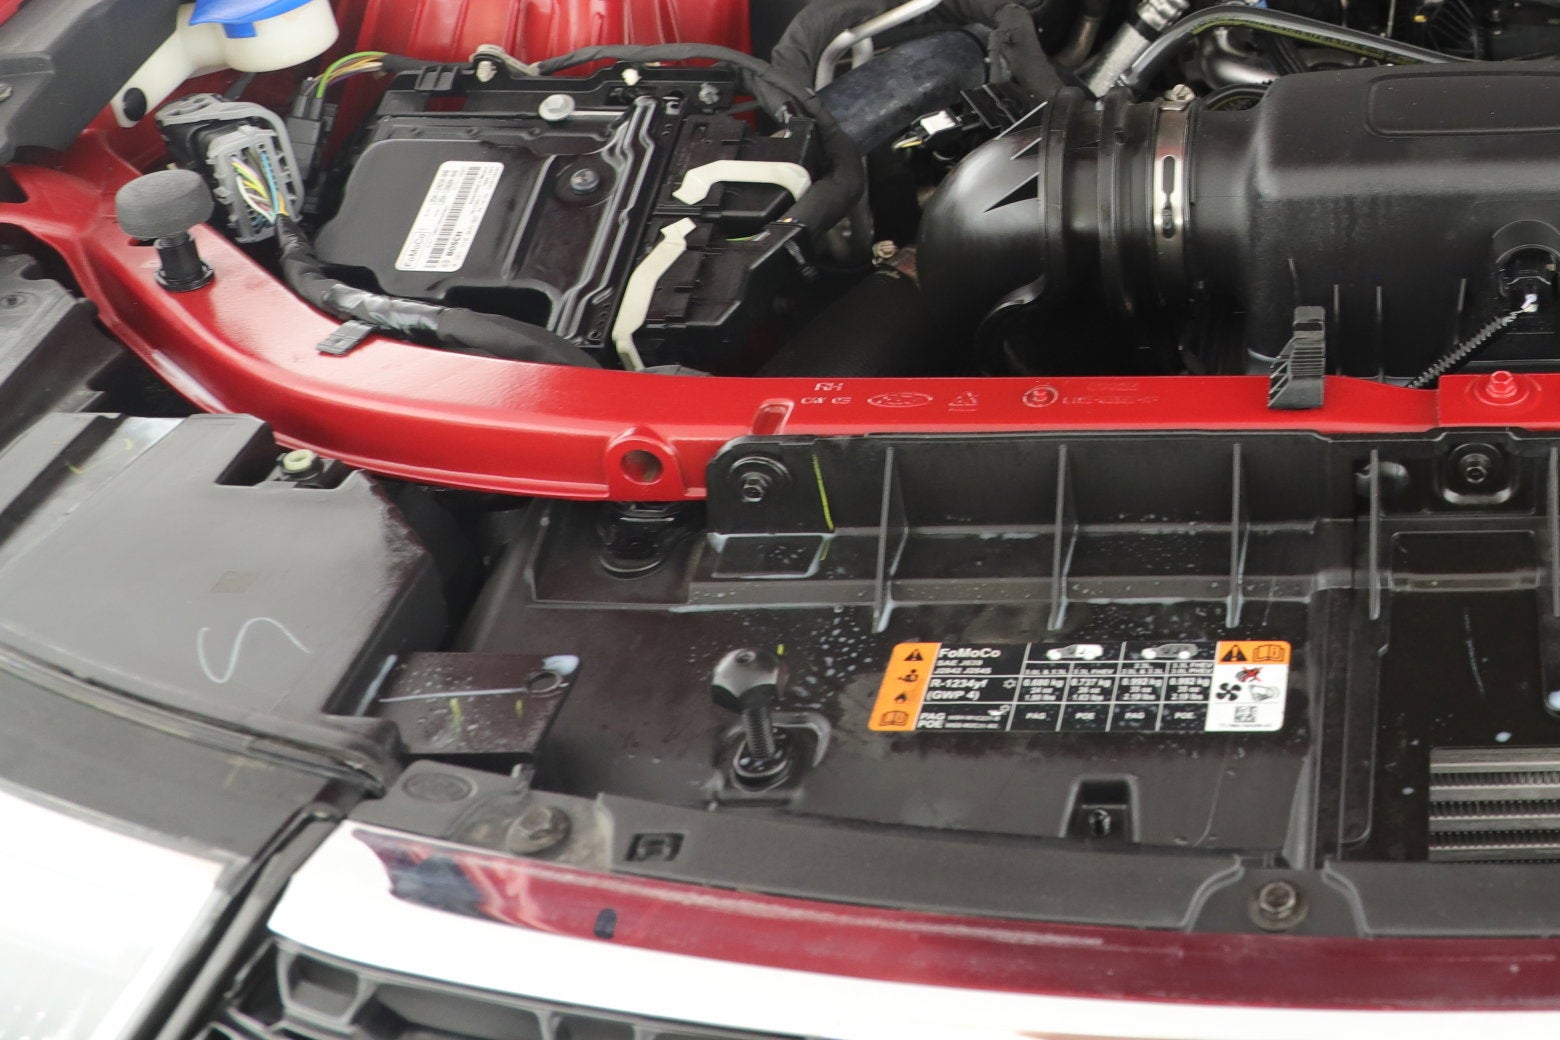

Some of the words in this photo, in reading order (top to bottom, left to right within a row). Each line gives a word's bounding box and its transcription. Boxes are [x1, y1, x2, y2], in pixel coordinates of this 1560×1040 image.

[446, 231, 463, 257] BOSCH
[938, 647, 1002, 658] FoMoCo
[929, 678, 989, 689] R-1234yf
[1050, 678, 1065, 688] kg
[1097, 678, 1112, 688] kg
[1149, 677, 1163, 687] kg
[1197, 677, 1210, 687] kg
[926, 690, 966, 701] (GWP
[965, 690, 981, 700] 4)
[919, 712, 946, 720] PAG
[917, 720, 944, 729] POE
